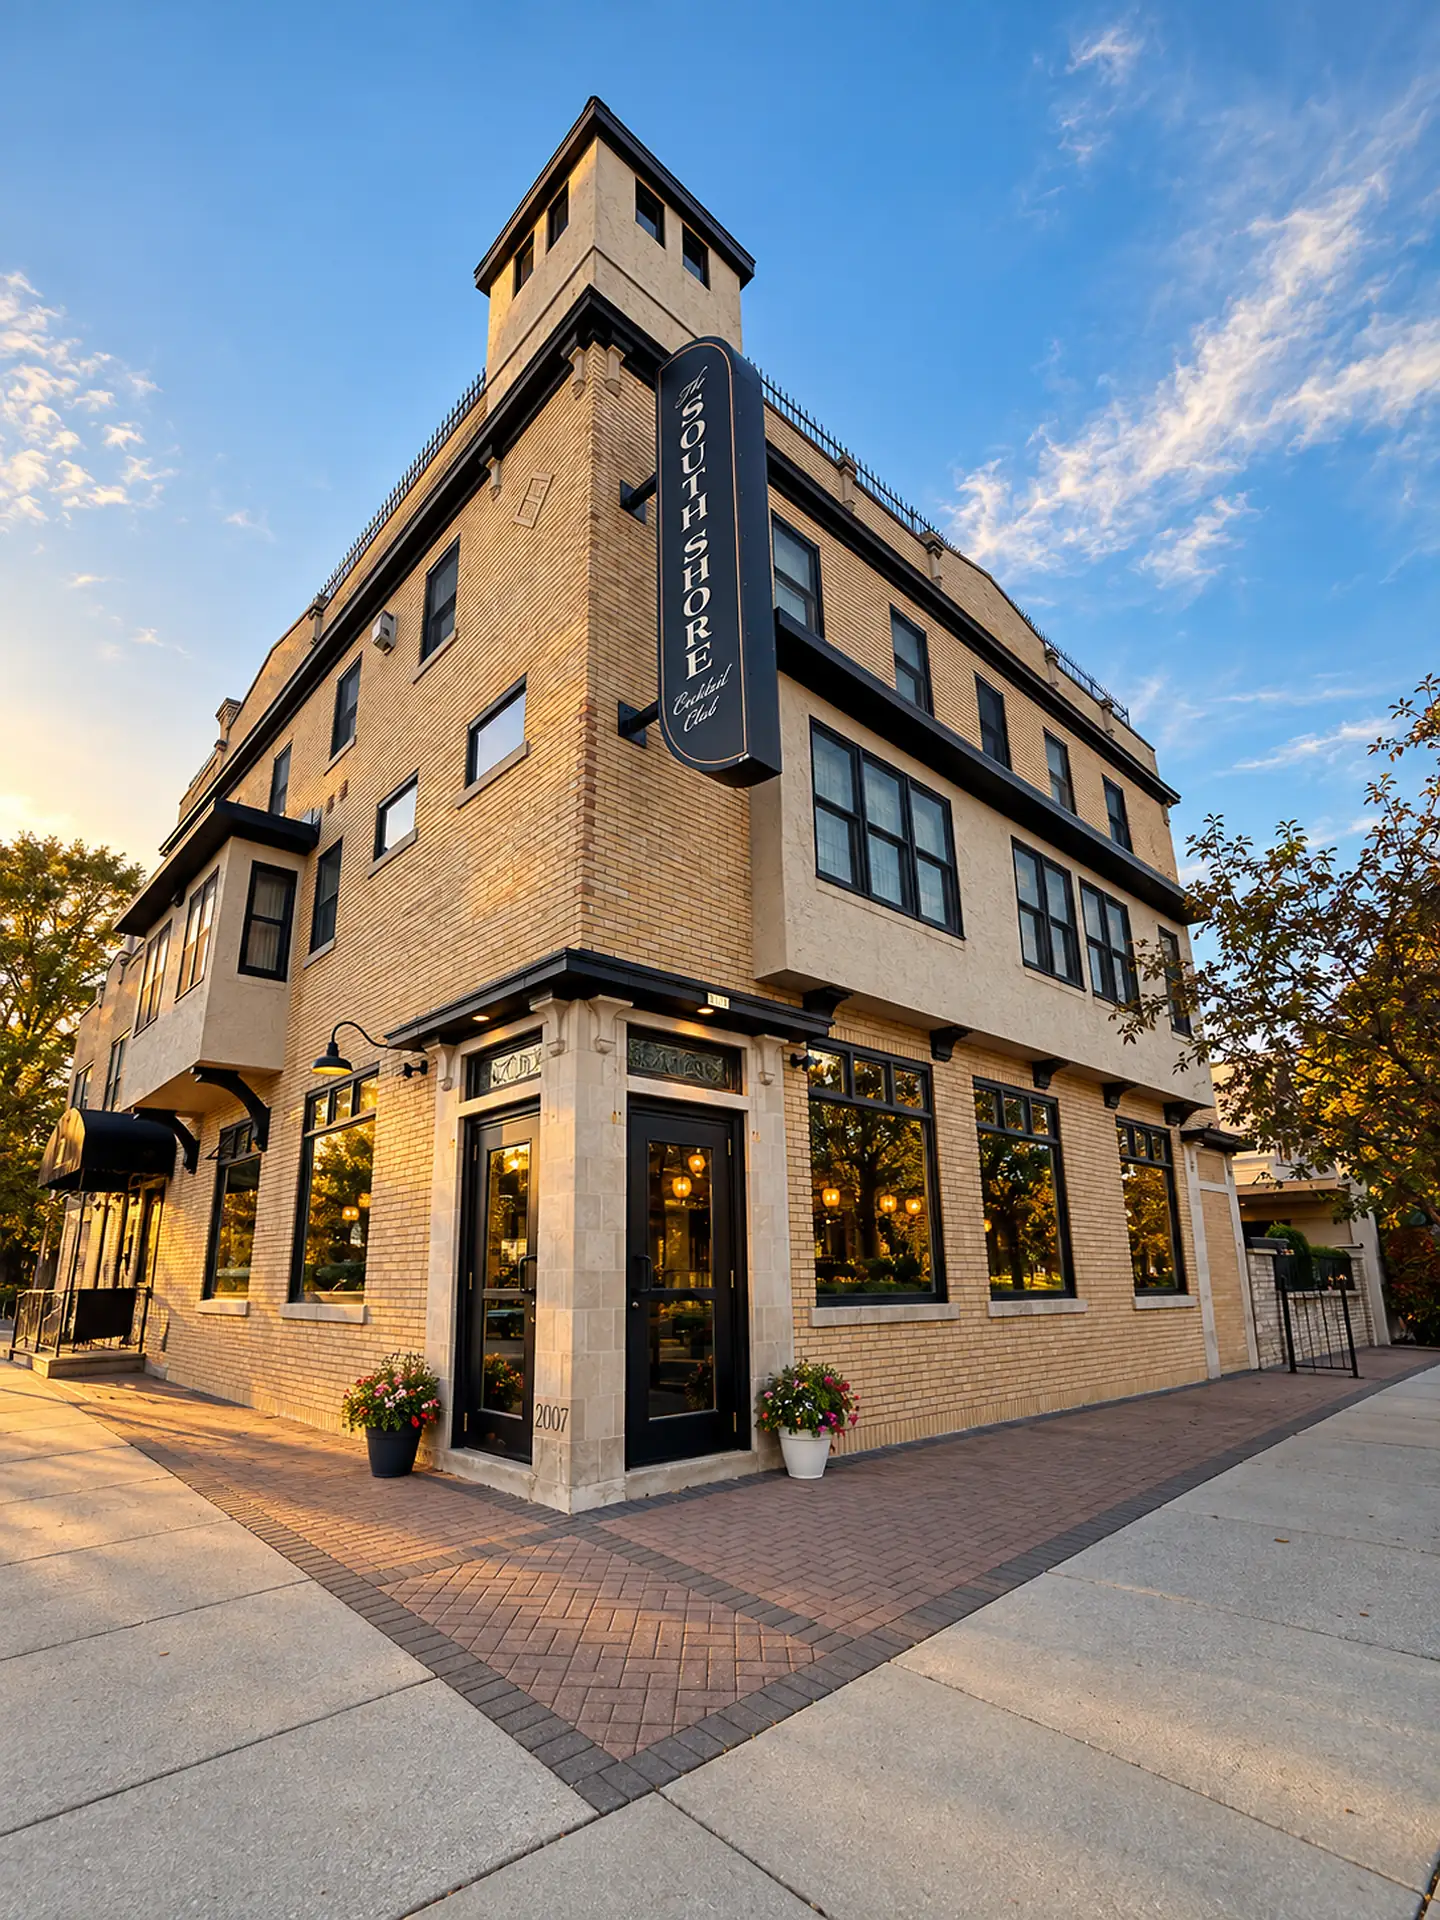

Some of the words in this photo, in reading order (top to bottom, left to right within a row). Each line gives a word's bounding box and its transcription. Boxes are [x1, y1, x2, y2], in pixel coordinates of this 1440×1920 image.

[680, 393, 709, 533] SOUTH
[682, 528, 713, 681] SHORE
[535, 1403, 569, 1433] 2007
